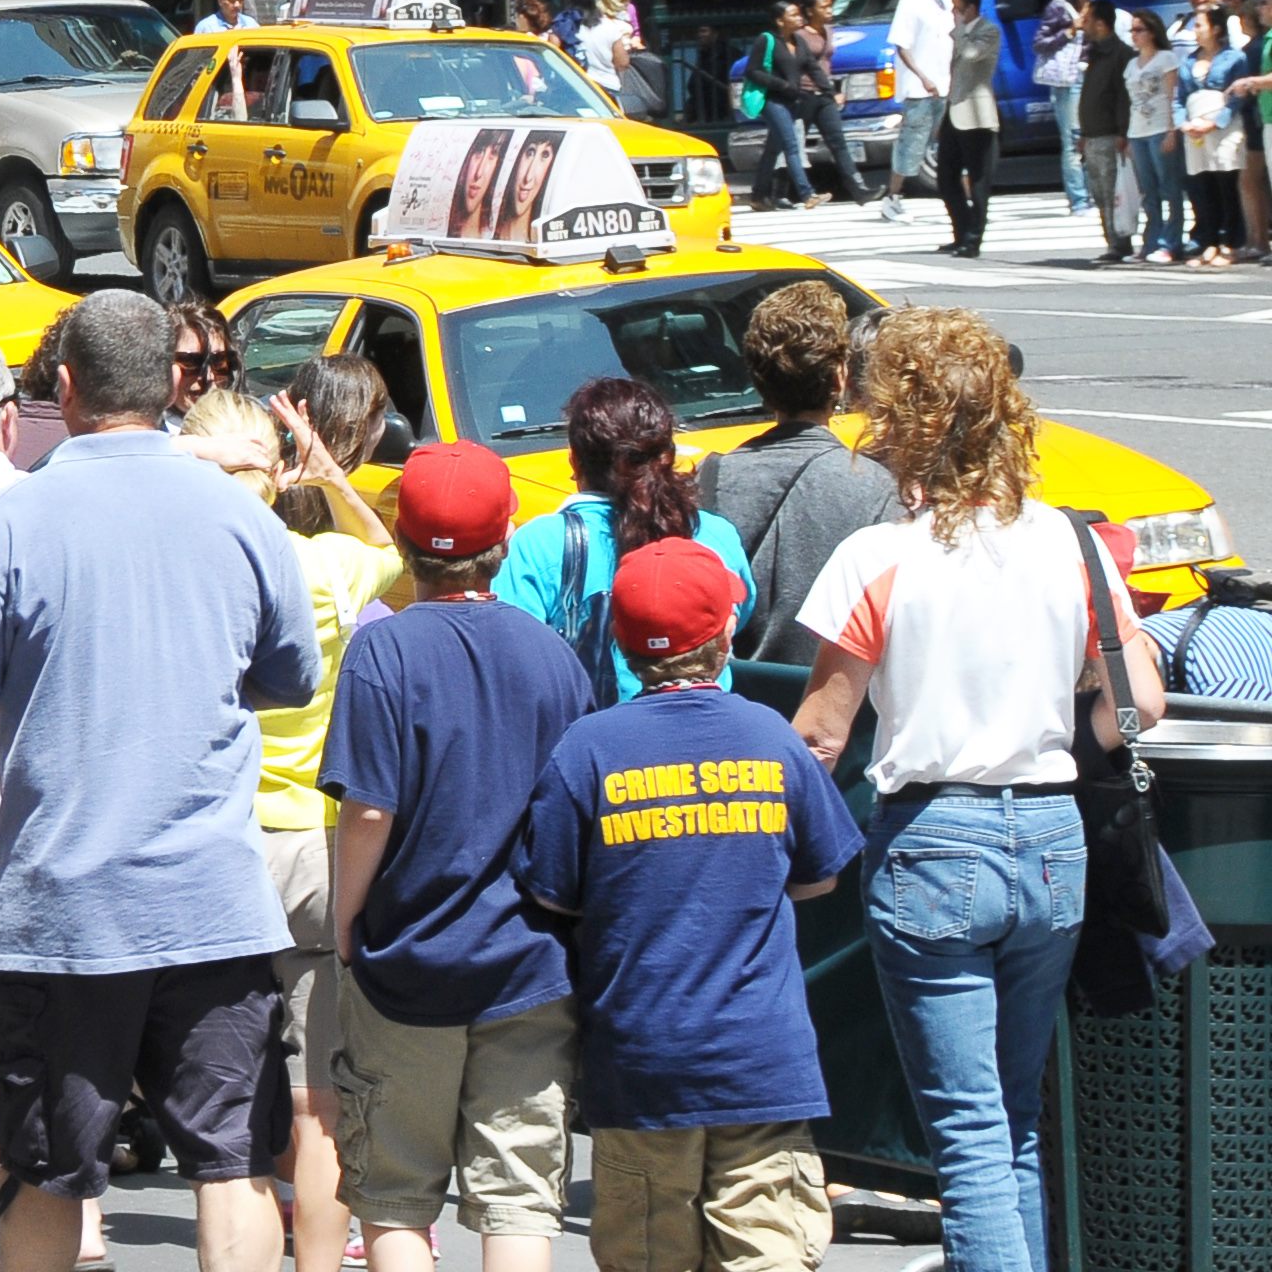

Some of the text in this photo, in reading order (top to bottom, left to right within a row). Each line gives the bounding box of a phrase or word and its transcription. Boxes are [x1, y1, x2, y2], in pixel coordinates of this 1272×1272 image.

[263, 174, 290, 197] NYC
[573, 208, 633, 237] 4N80
[603, 759, 786, 805] CRIME SCENE
[600, 800, 788, 846] INVESTIGATOR
